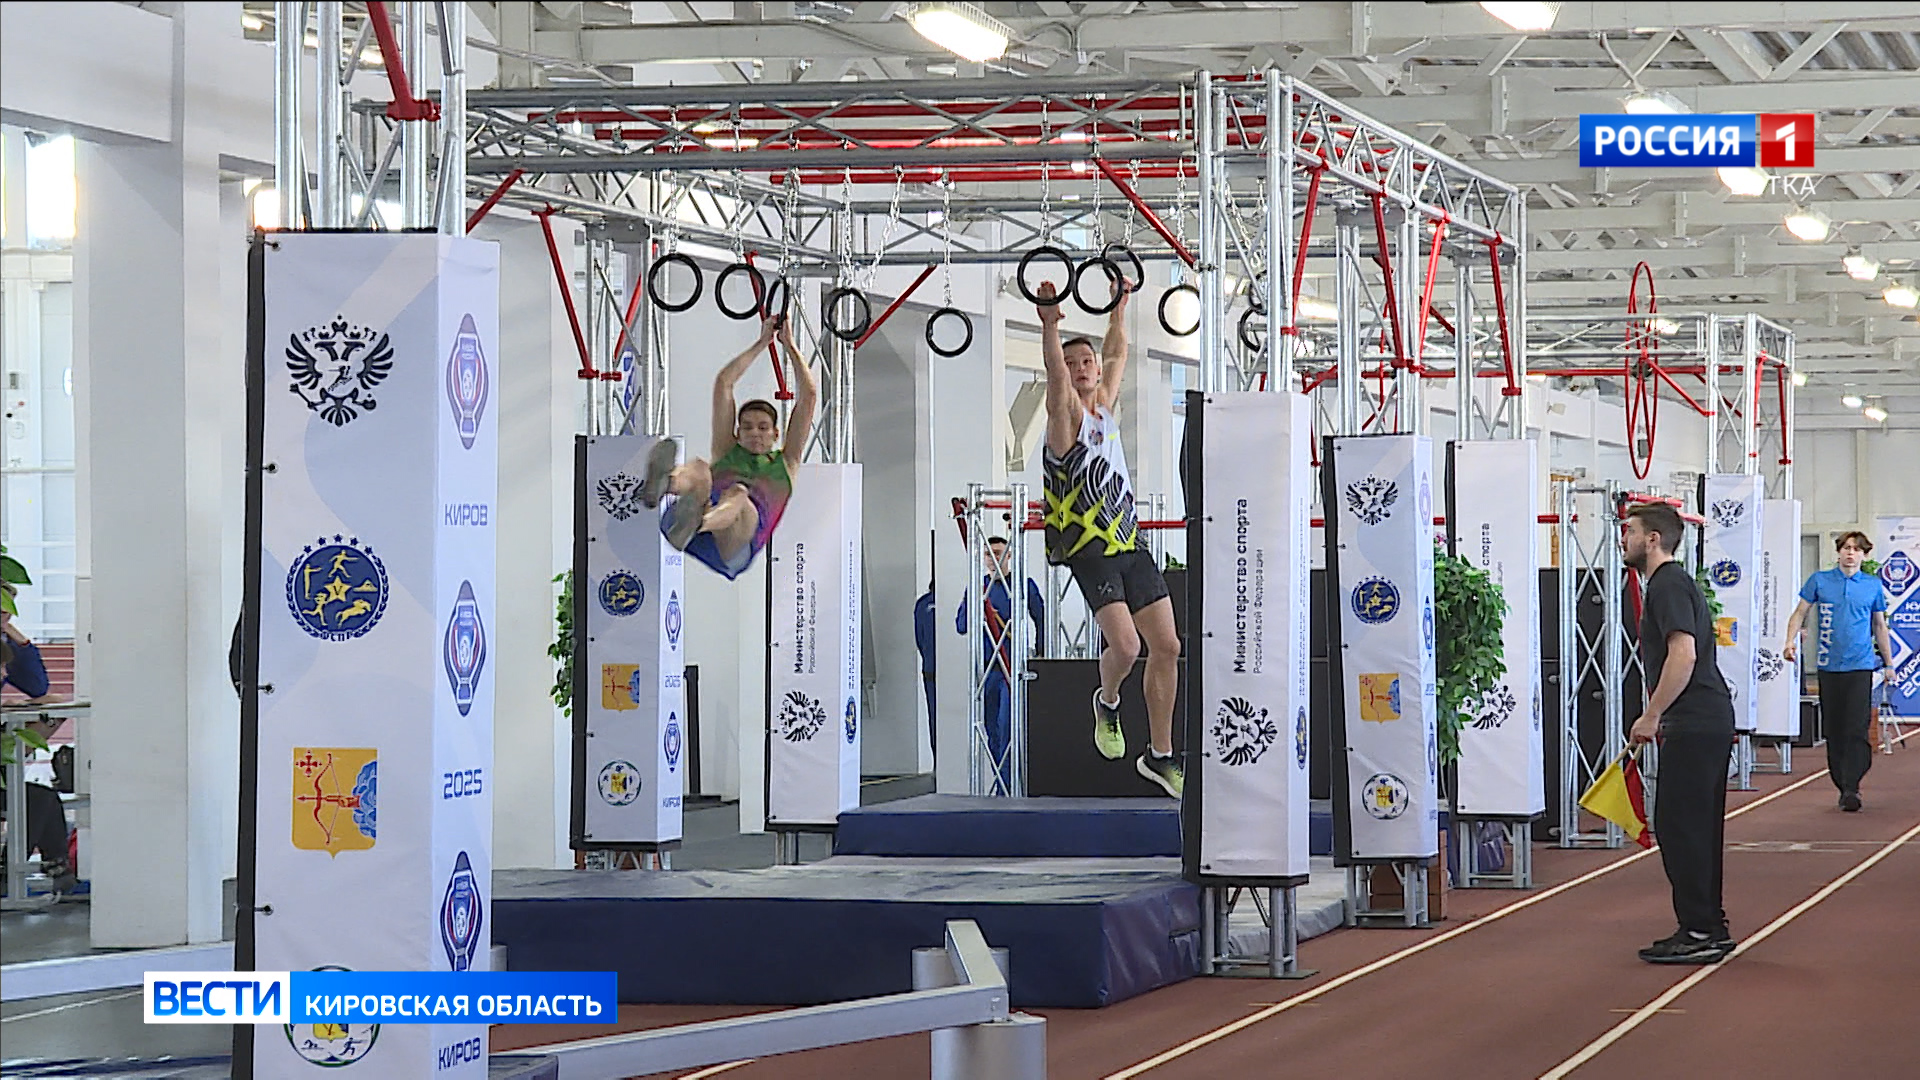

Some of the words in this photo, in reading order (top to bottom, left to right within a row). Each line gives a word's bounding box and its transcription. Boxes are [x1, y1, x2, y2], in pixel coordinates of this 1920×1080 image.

[444, 503, 488, 526] КИРОВ
[1236, 498, 1250, 554] спорта
[796, 543, 806, 584] спорта
[1481, 523, 1492, 566] спорта
[794, 586, 805, 674] Министерство
[1234, 556, 1249, 674] Министерство
[1817, 603, 1834, 666] СУДЬЯ
[443, 768, 482, 800] 2025
[438, 1037, 481, 1071] КИРОВ
